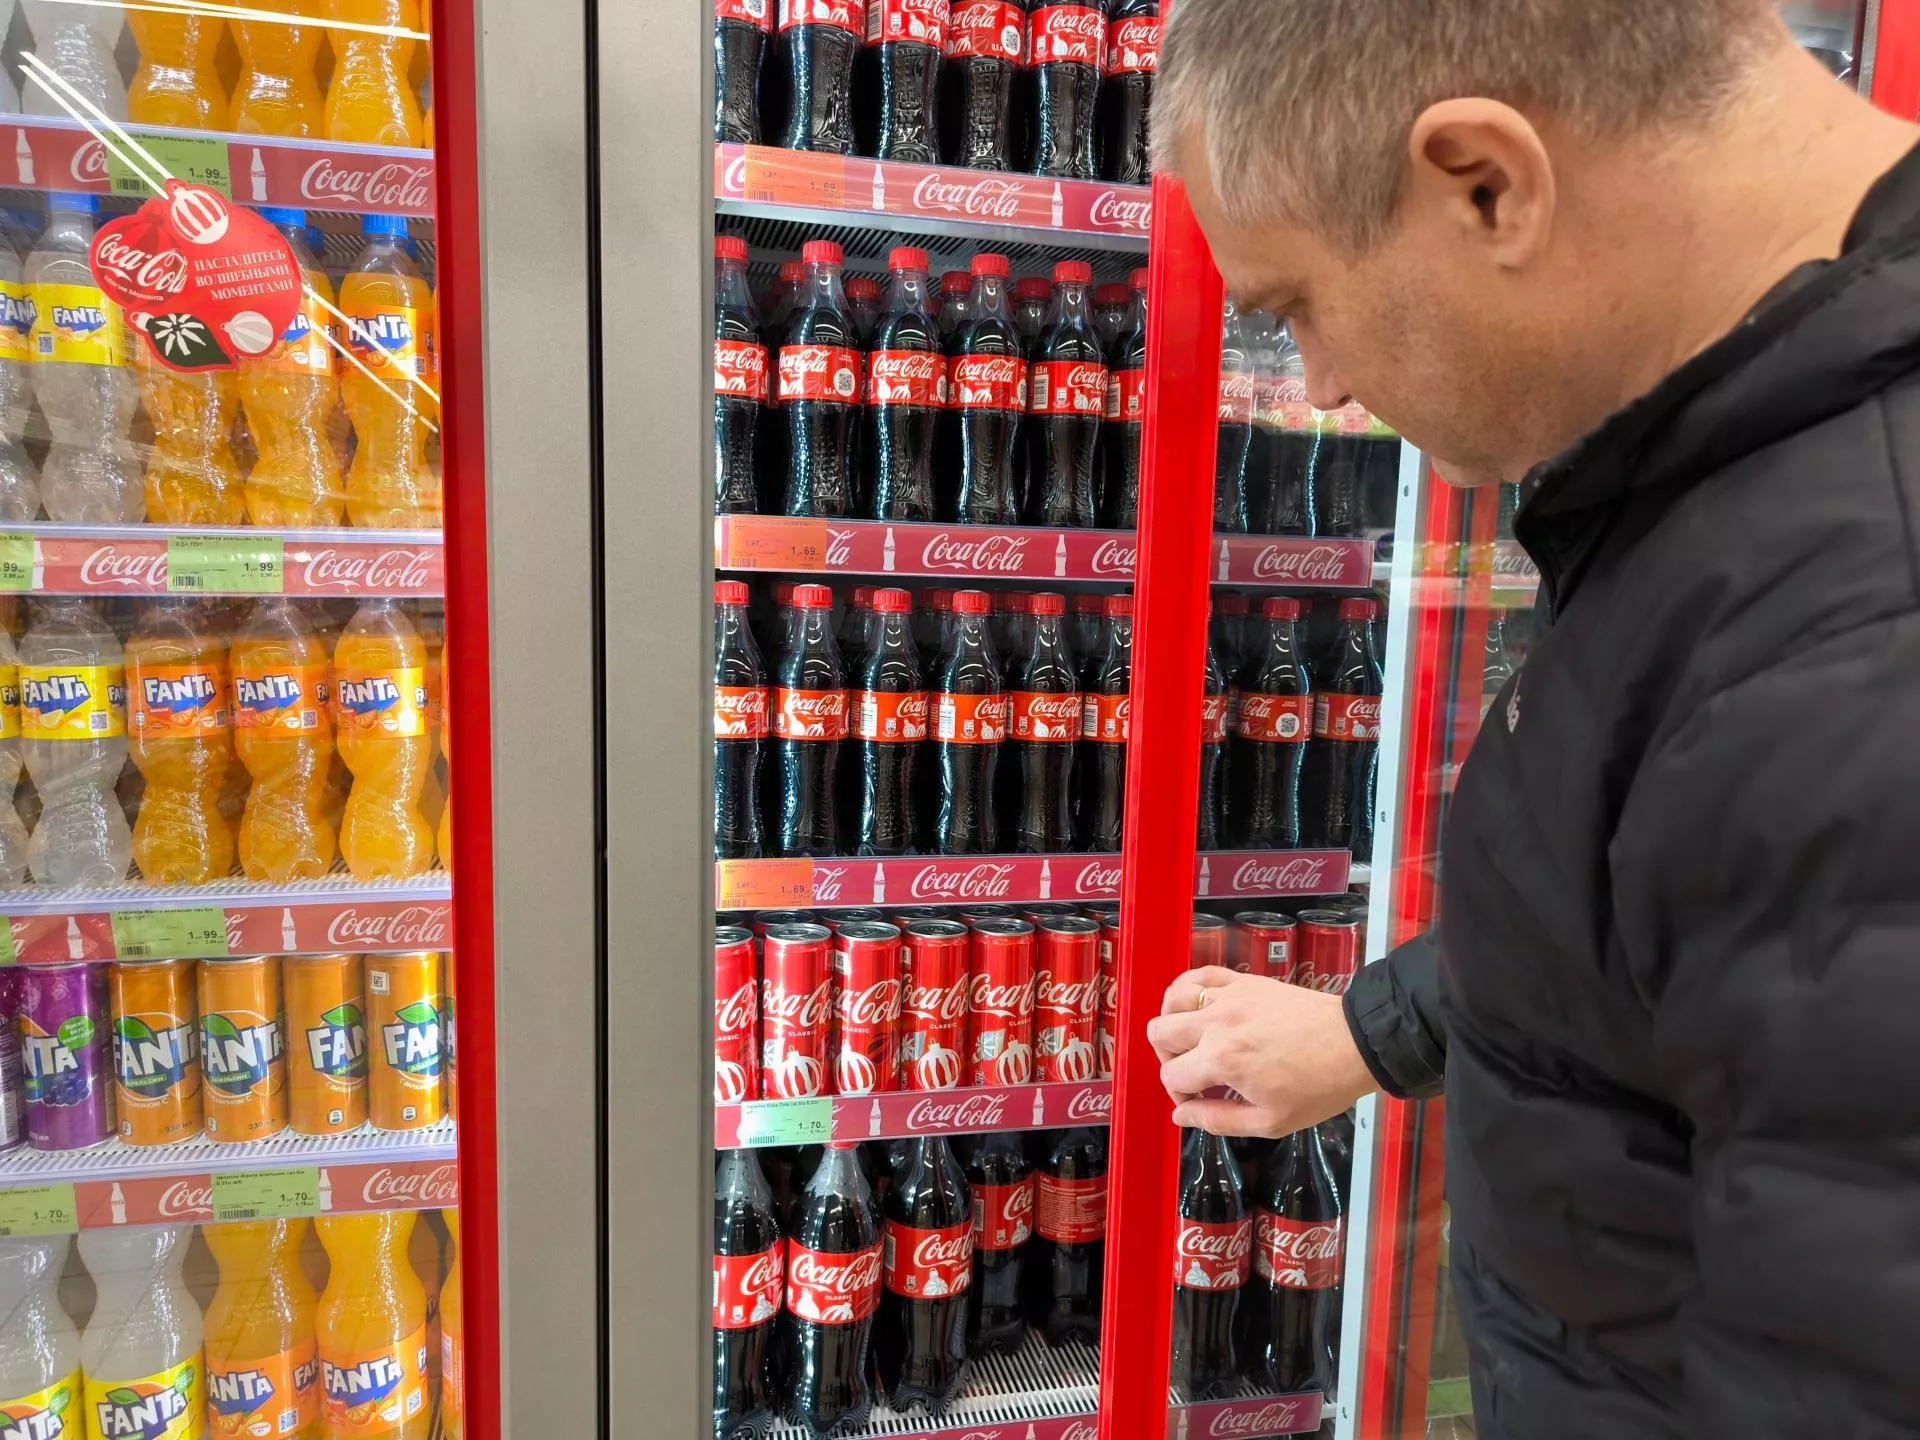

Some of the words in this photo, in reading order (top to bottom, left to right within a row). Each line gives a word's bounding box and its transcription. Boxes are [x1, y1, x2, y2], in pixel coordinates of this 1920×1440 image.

[1046, 9, 1106, 39] Coca-Cola
[301, 157, 432, 208] Coca-Cola
[912, 173, 1025, 219] Coca-Cola
[96, 233, 188, 294] Coca-Cola
[195, 264, 290, 287] ВОЛШЕБНЫМИ
[211, 279, 294, 301] МОМЕНТАМИ
[52, 306, 107, 325] FANTA
[873, 354, 936, 379] Coca-Cola
[955, 359, 1016, 384] Coca-Cola
[803, 546, 816, 556] 69
[921, 532, 1031, 571] Coca-Cola
[1253, 544, 1351, 581] Coca-Cola
[3, 562, 18, 573] 99
[260, 562, 274, 572] 99
[304, 546, 440, 588] Coca-Cola
[22, 676, 89, 703] FANTA
[144, 674, 216, 703] FANTA
[236, 676, 301, 703] FANTA
[339, 678, 400, 704] FANTA
[785, 690, 845, 716] Coca-Cola
[911, 863, 1016, 899] Coca-Cola
[1233, 857, 1328, 891] Coca-Cola
[793, 884, 805, 894] 69
[204, 930, 218, 939] 99
[327, 906, 448, 946] Coca-Cola
[715, 1034, 739, 1042] LASSIC
[810, 1121, 821, 1129] 70
[907, 1095, 1009, 1129] Coca-Cola
[295, 1192, 308, 1201] 70
[49, 1209, 63, 1219] 70
[1253, 1214, 1339, 1259] Coca-Cola
[791, 1245, 882, 1293] Coca-Cola
[207, 1370, 273, 1402] ANTA
[323, 1358, 402, 1394] FANTA
[98, 1388, 187, 1438] FANTA
[1209, 1401, 1301, 1437] Coca-Cola
